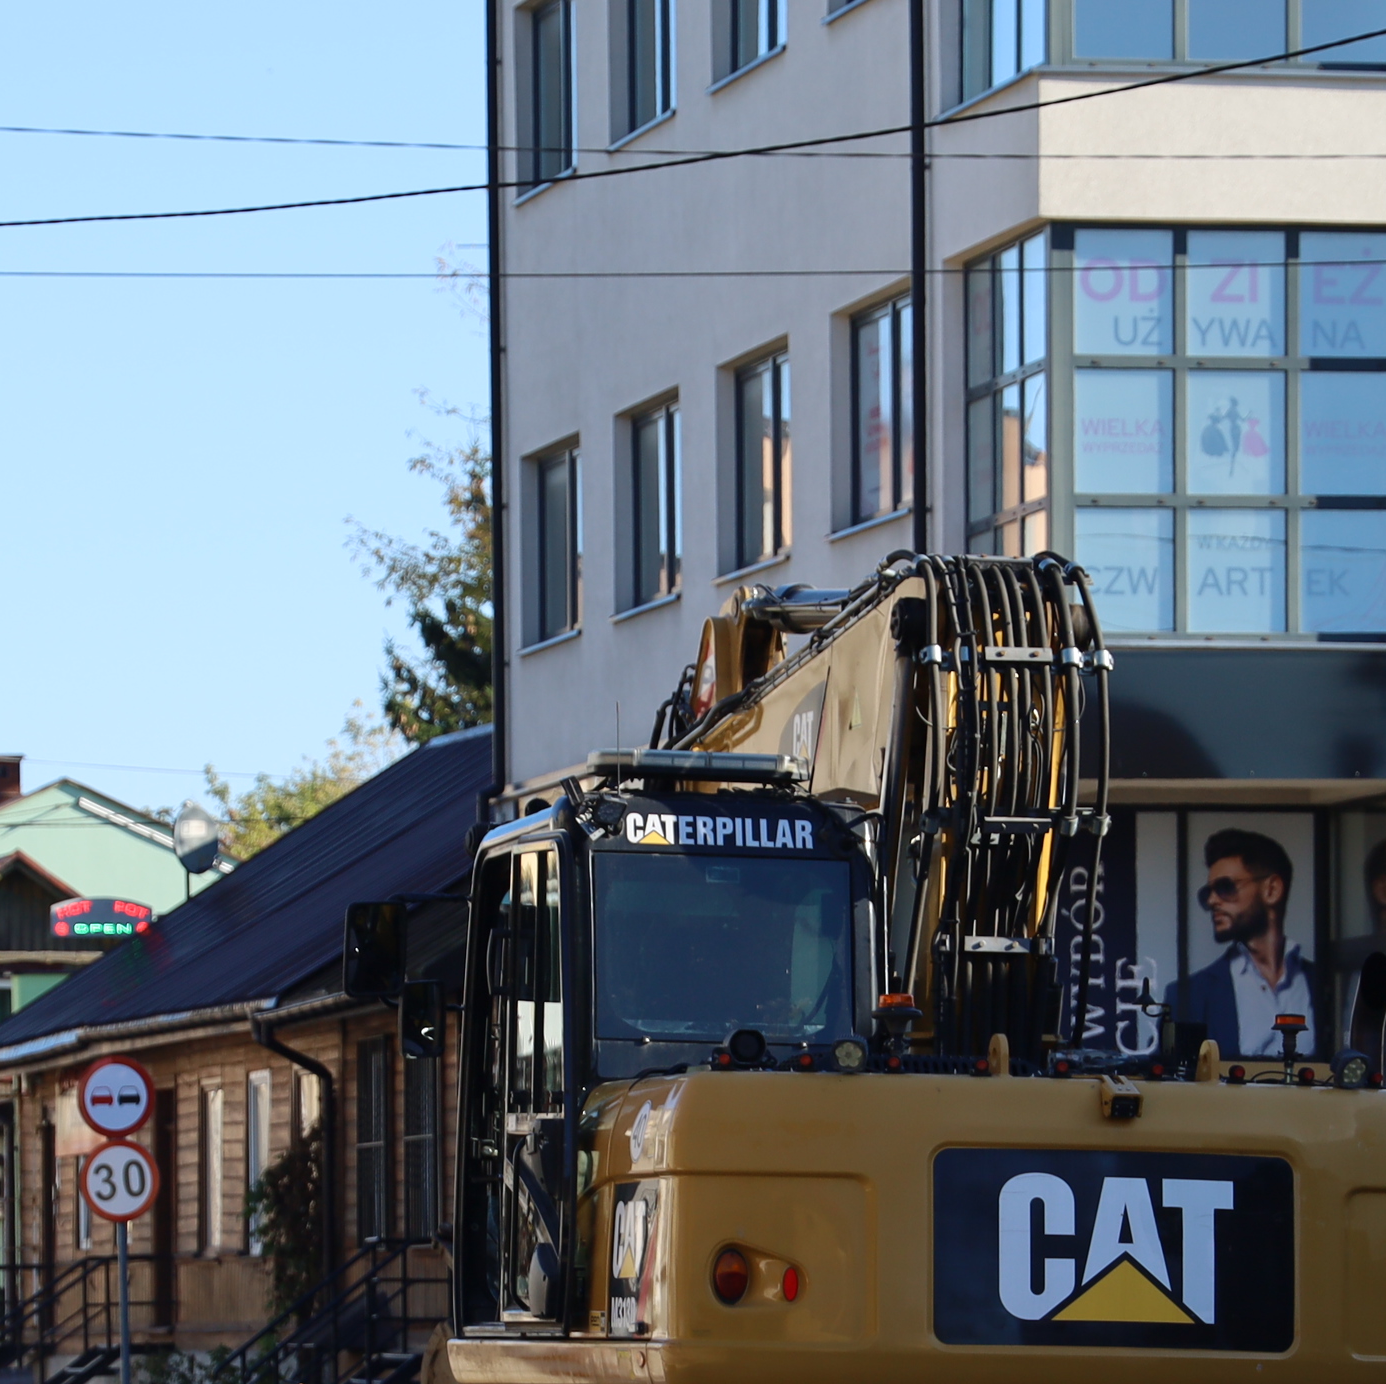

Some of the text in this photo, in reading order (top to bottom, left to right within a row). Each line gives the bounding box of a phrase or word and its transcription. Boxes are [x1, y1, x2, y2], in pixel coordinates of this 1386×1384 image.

[1081, 418, 1166, 437] WIELKA
[793, 710, 814, 766] CAT
[625, 812, 813, 849] CATERPILLAR
[73, 922, 133, 935] OPEN
[113, 900, 150, 919] POT
[92, 1159, 146, 1202] 30
[613, 1200, 648, 1279] CAT
[999, 1172, 1234, 1324] CAT
